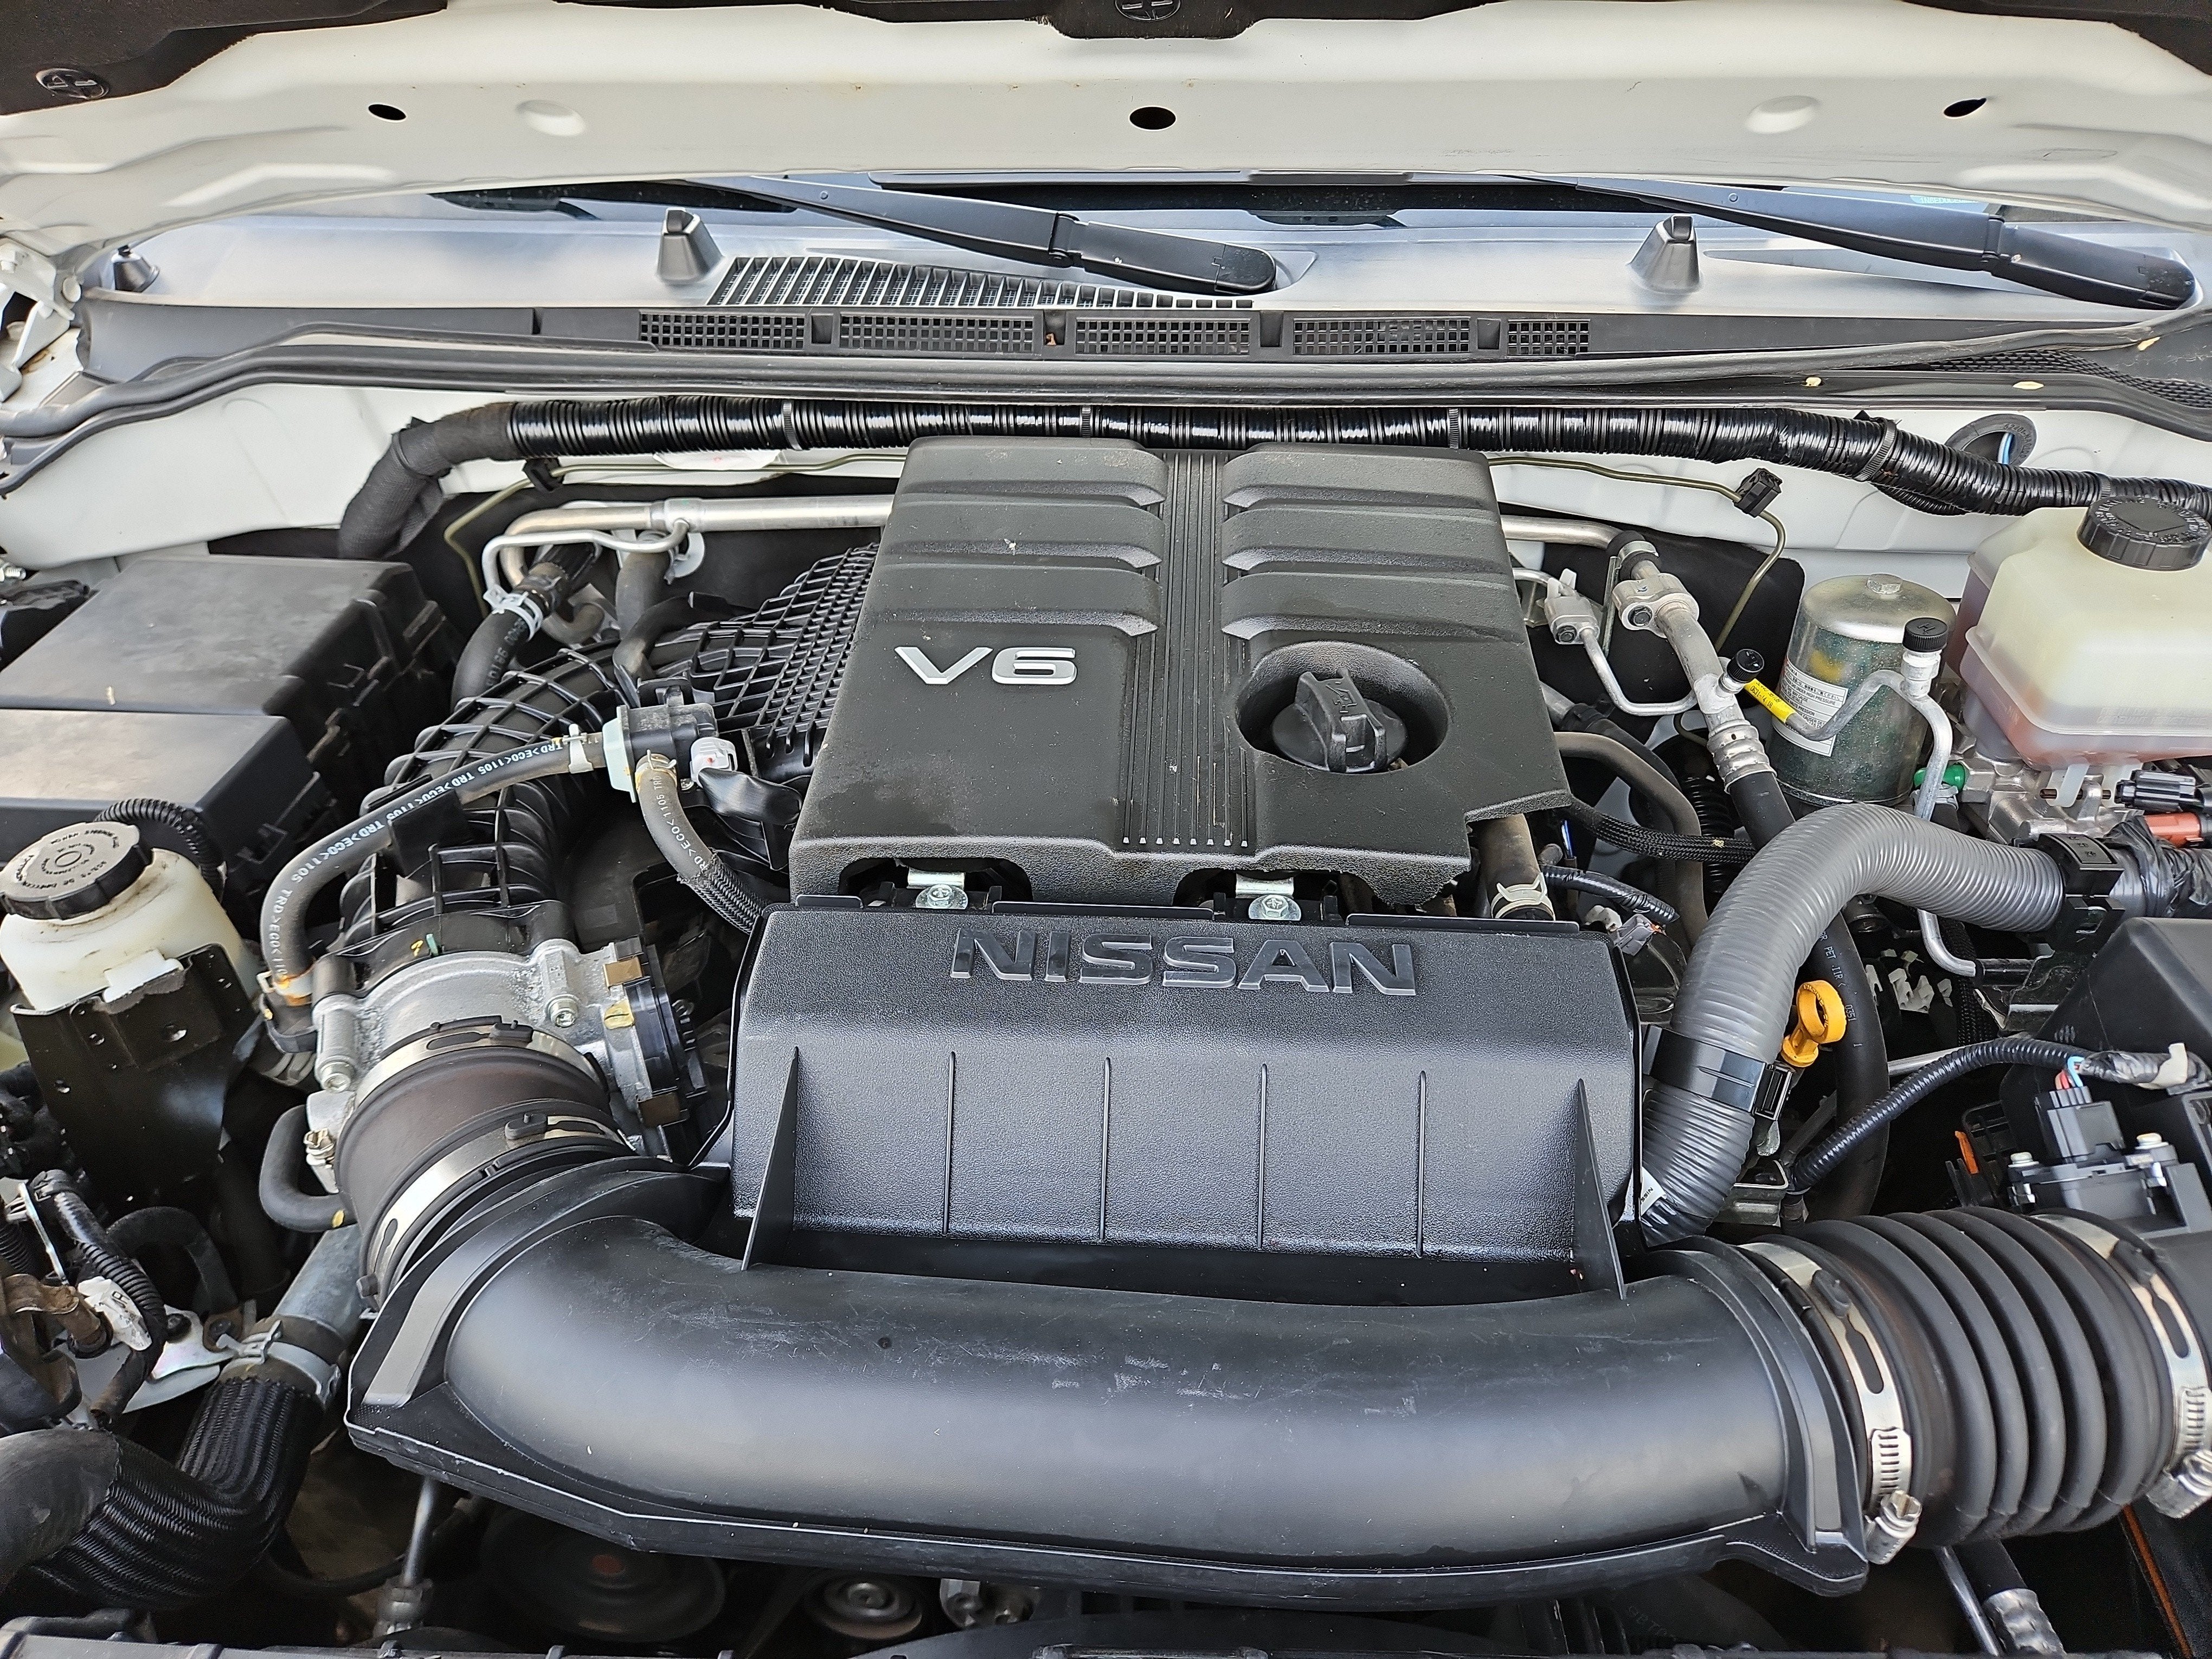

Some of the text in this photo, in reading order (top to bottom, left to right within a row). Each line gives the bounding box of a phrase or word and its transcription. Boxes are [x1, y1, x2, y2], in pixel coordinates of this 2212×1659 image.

[895, 647, 1077, 684] V6
[1816, 696, 1836, 705] PRESSURE
[1798, 705, 1815, 716] PRESSION
[653, 776, 663, 790] TRD
[951, 929, 1417, 996] NISSAN
[1824, 946, 1836, 960] PET
[1844, 1004, 1857, 1022] 0351
[1640, 1186, 1654, 1203] NISS
